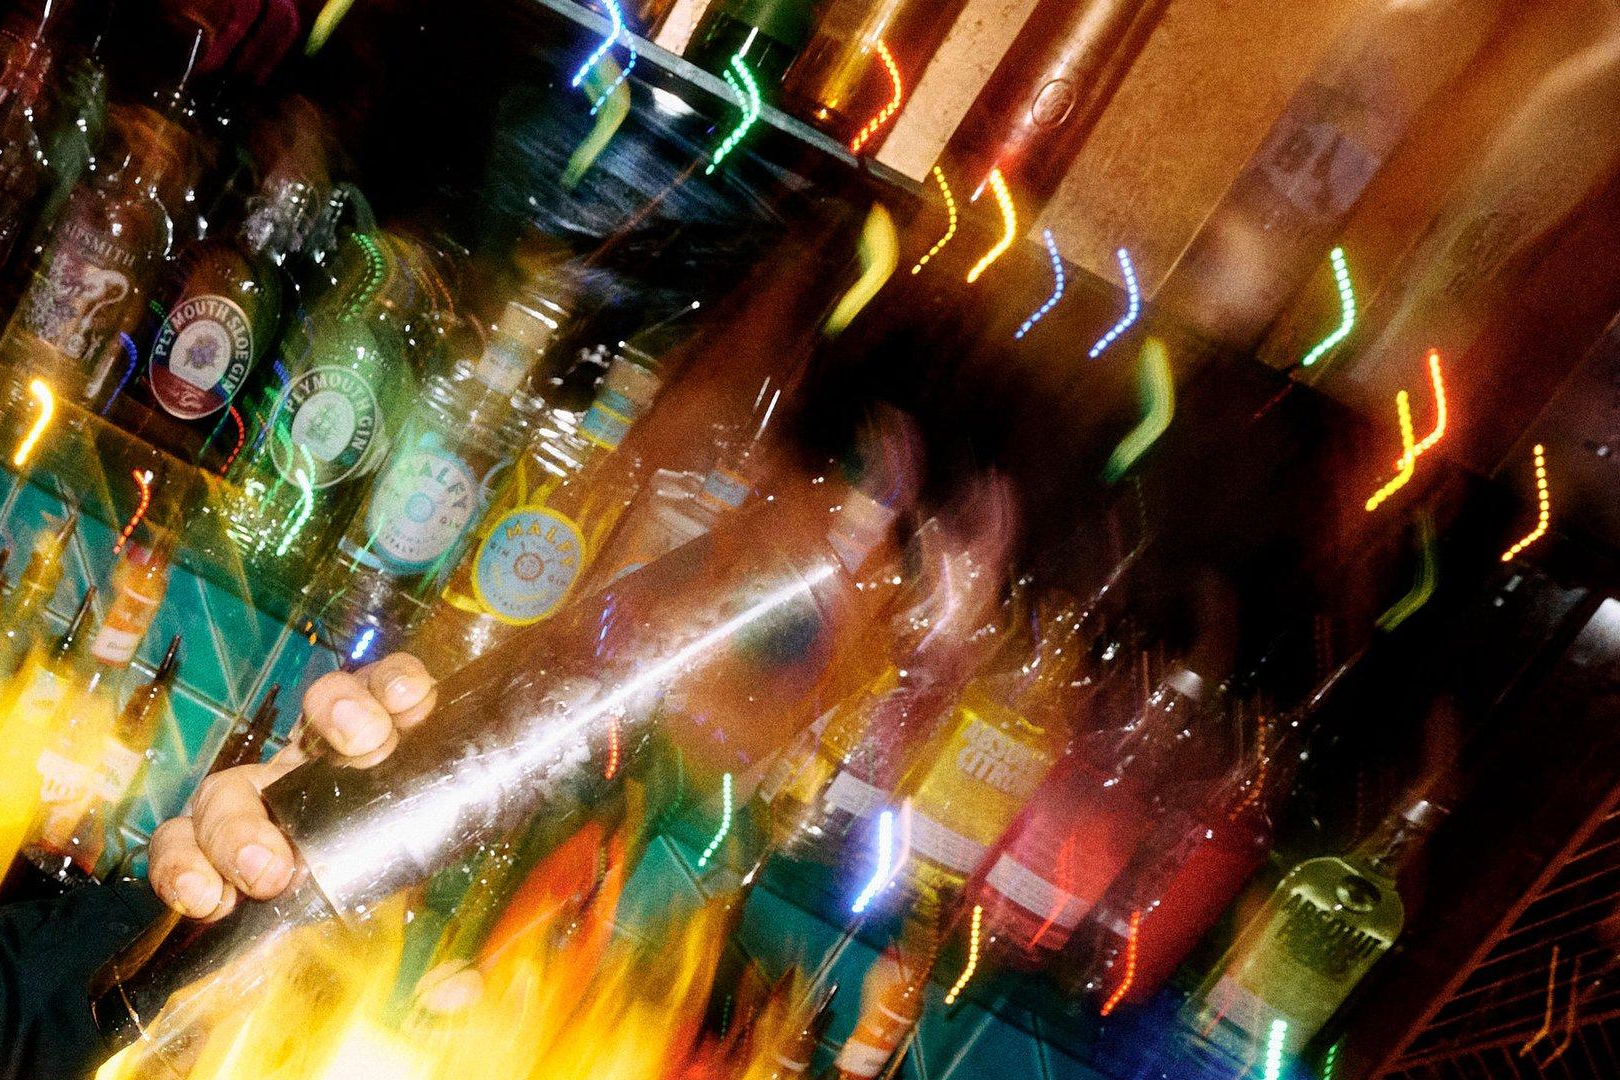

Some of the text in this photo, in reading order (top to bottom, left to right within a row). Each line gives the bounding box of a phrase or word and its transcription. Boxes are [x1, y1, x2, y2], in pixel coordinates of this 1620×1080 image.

[155, 300, 249, 396] PLYMOUTH SLOE GIN
[351, 415, 373, 451] GIN
[506, 520, 576, 567] MALFY
[1277, 893, 1382, 958] ABSOLUT
